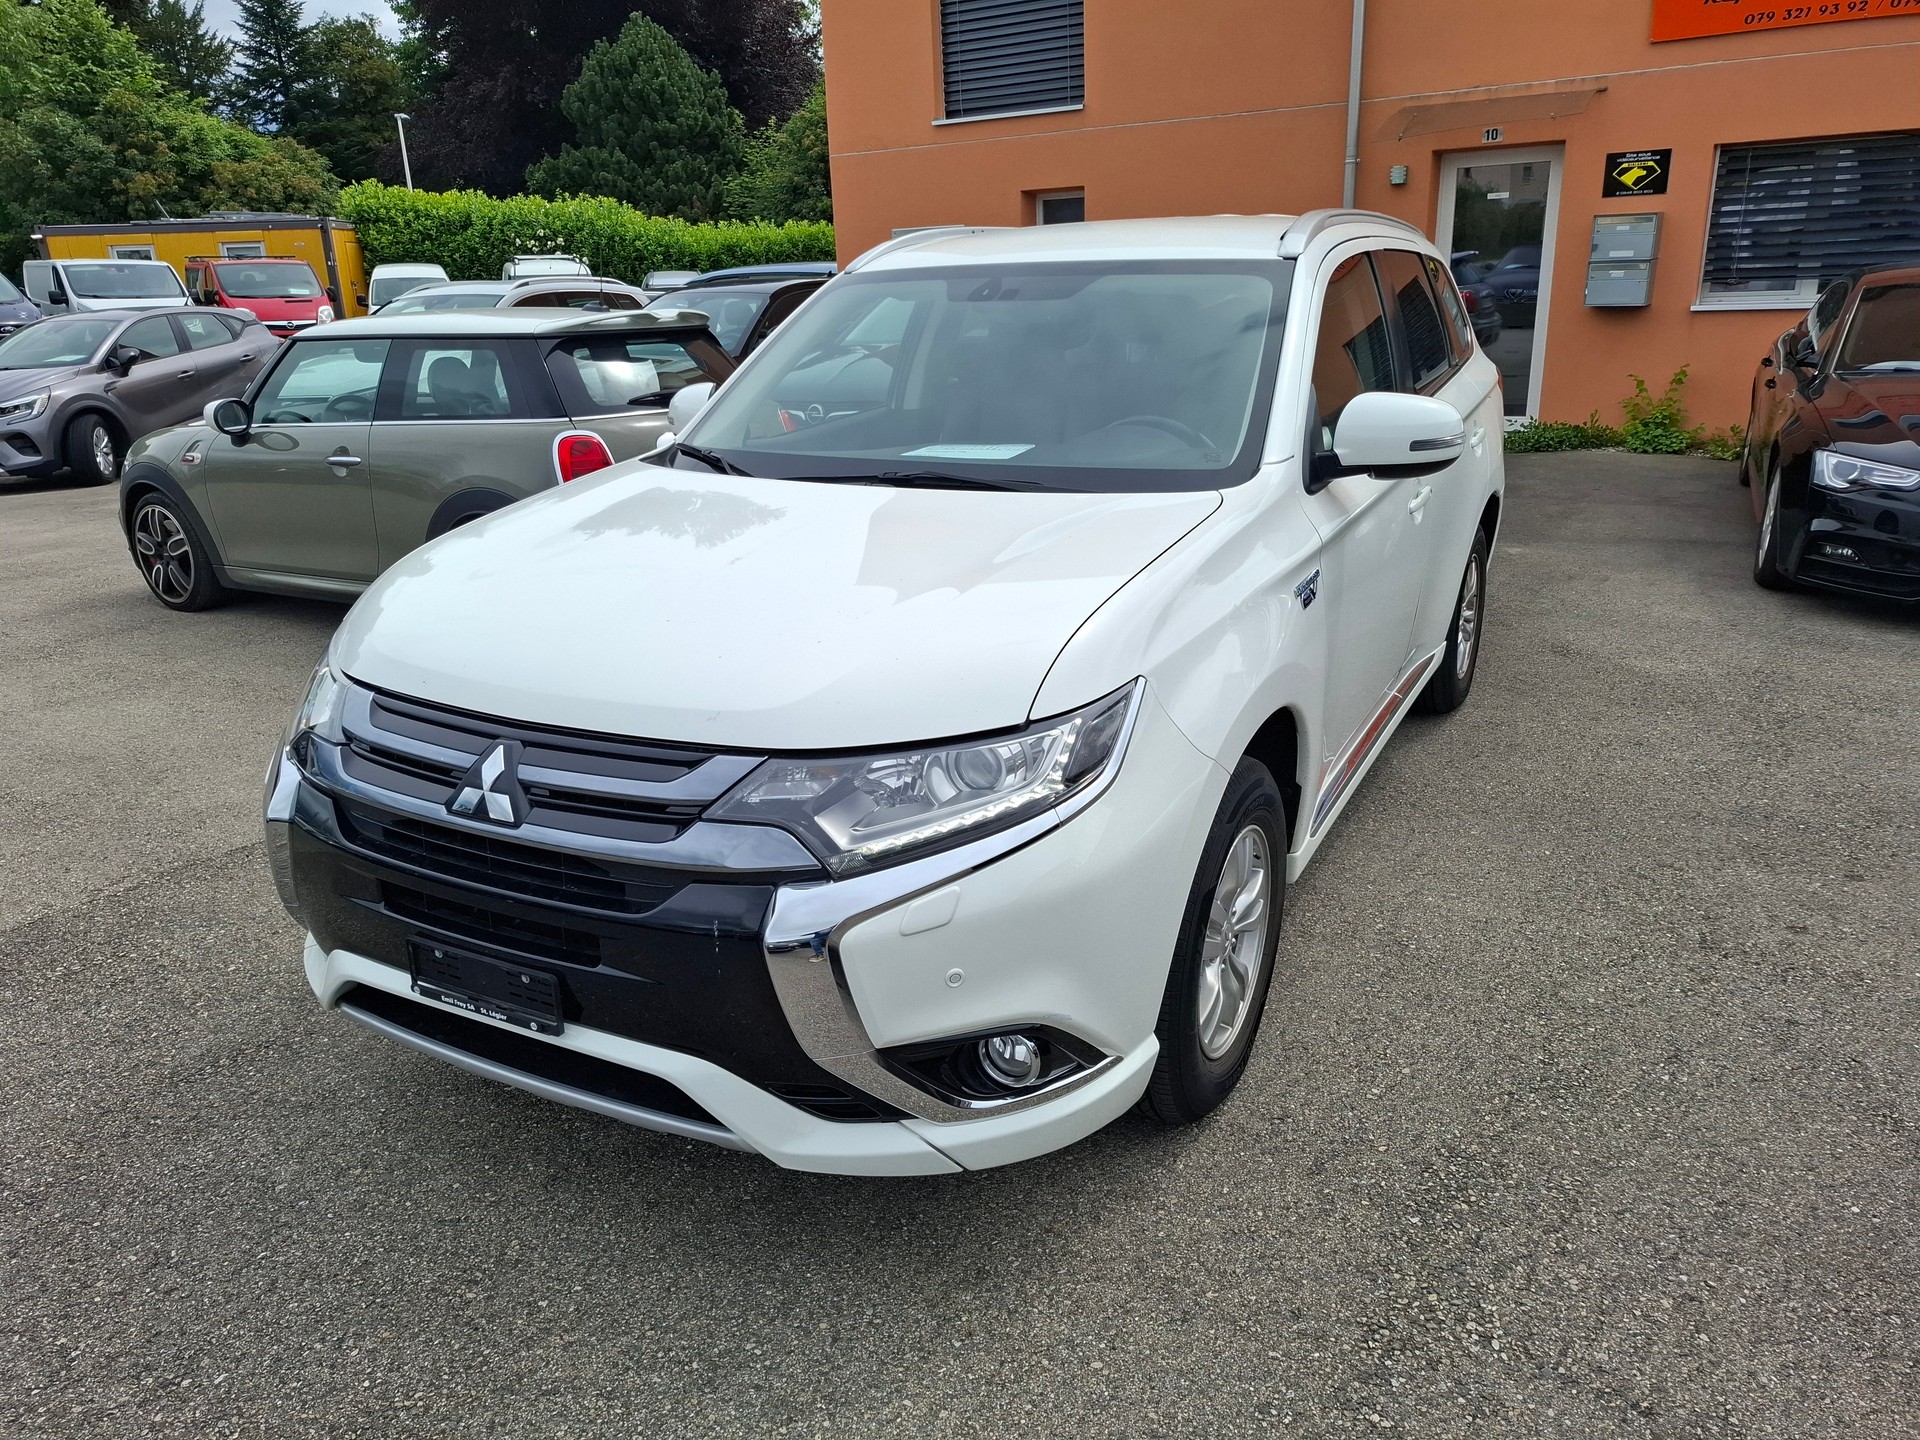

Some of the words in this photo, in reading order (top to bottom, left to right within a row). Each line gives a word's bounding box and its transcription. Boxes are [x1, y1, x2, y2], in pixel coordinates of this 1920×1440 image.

[1744, 11, 1776, 25] 079
[1782, 7, 1812, 21] 321
[1818, 3, 1840, 16] 93
[1847, 0, 1869, 13] 92
[1485, 128, 1498, 141] 10
[454, 1000, 466, 1008] Frey
